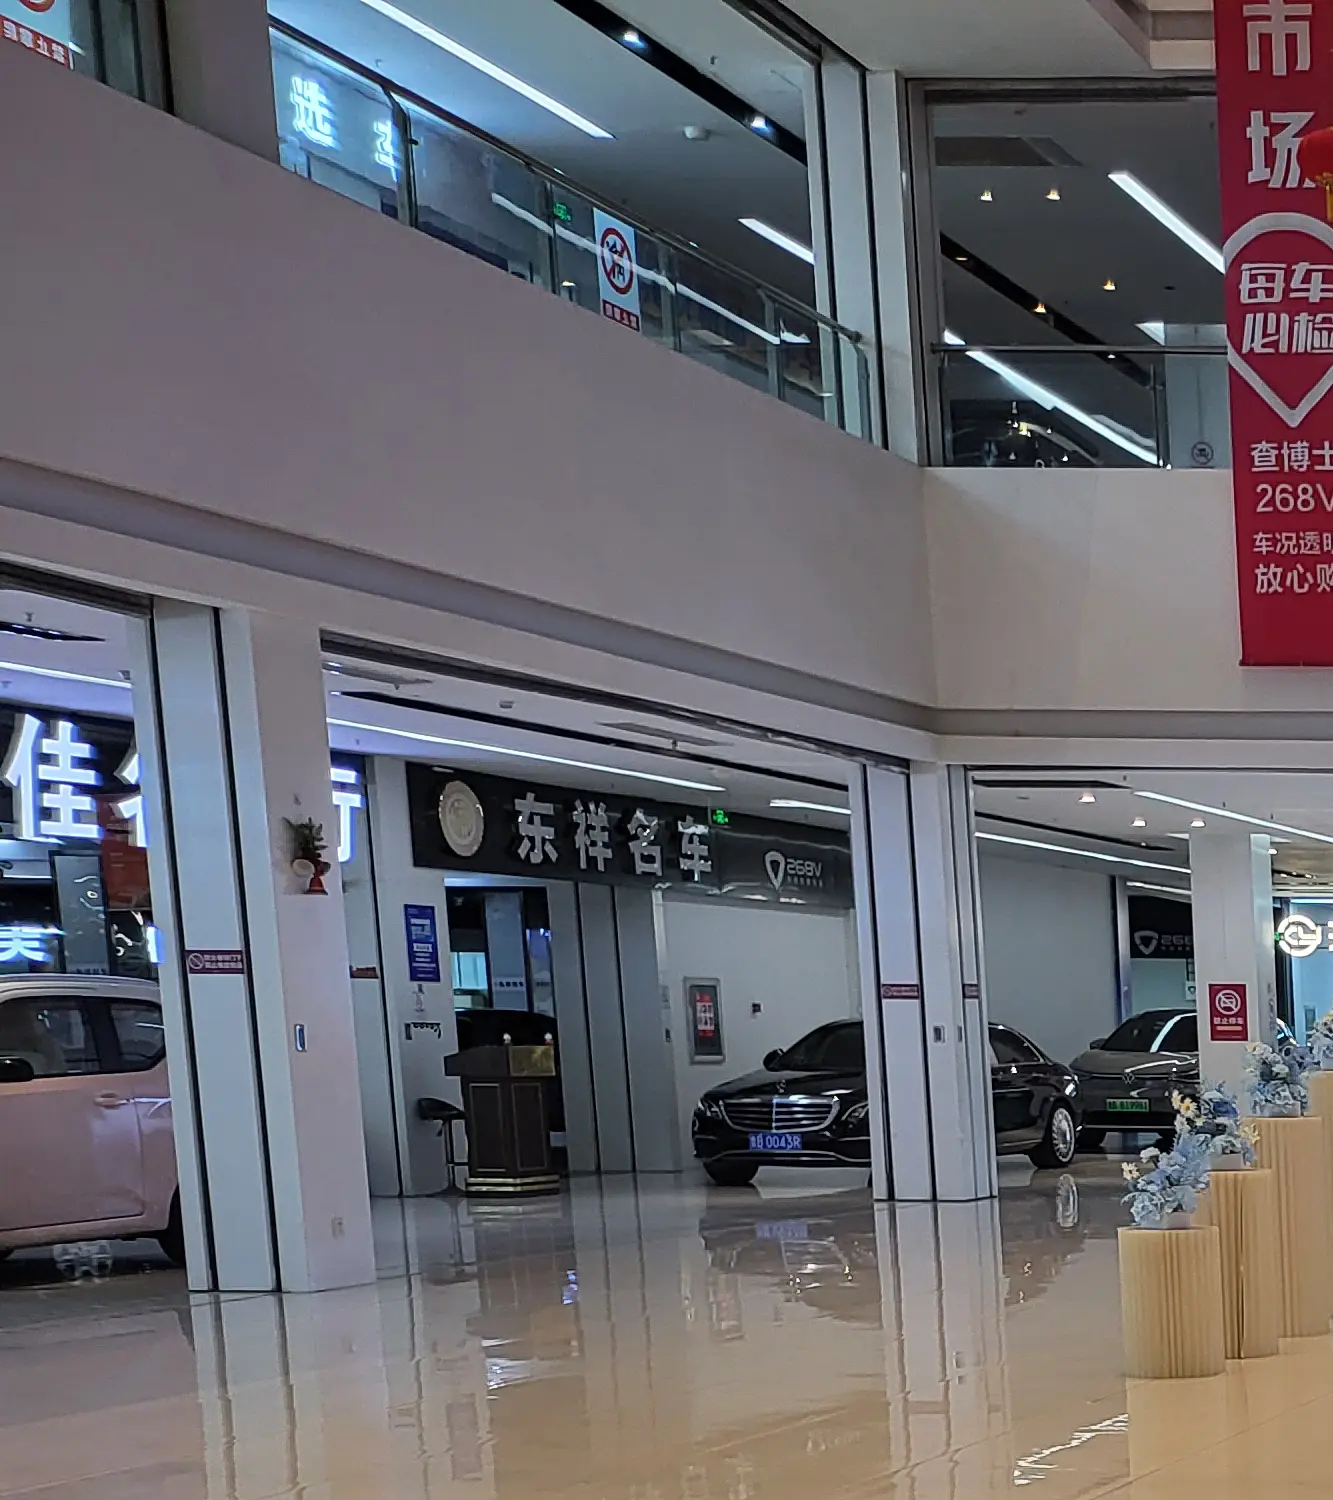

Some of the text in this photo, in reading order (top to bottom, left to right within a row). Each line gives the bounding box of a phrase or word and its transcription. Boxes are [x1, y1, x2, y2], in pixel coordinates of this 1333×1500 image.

[1243, 0, 1315, 188] 市场
[514, 791, 713, 882] 东祥名车
[786, 858, 822, 878] 268V
[1213, 1017, 1244, 1025] 禁止停车
